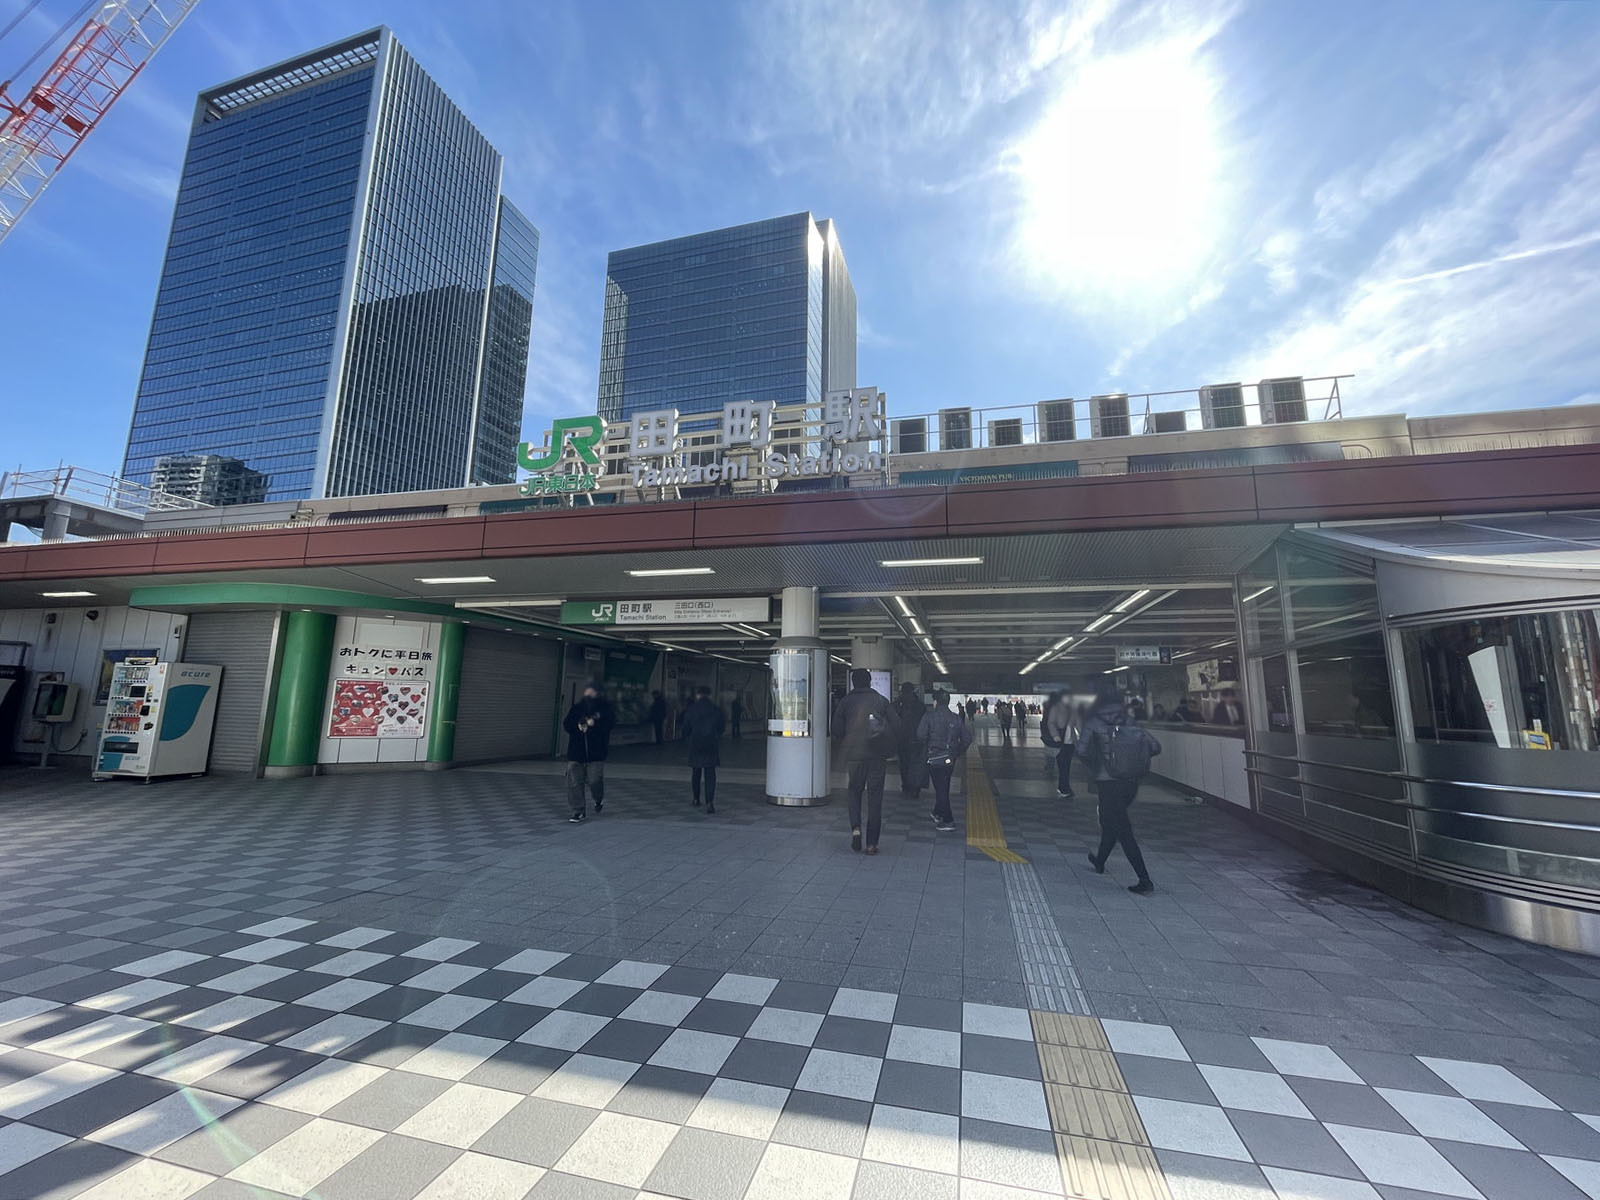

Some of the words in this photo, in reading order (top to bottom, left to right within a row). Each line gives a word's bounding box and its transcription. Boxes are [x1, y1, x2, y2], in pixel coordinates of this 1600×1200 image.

[629, 386, 881, 457] 田町駅
[516, 415, 604, 471] JR
[628, 455, 748, 488] Tamachi
[766, 447, 882, 477] Station
[519, 473, 598, 496] JR東日本
[592, 604, 613, 617] JR
[620, 603, 652, 613] 田町駅
[340, 647, 432, 661] おトクに平日旅
